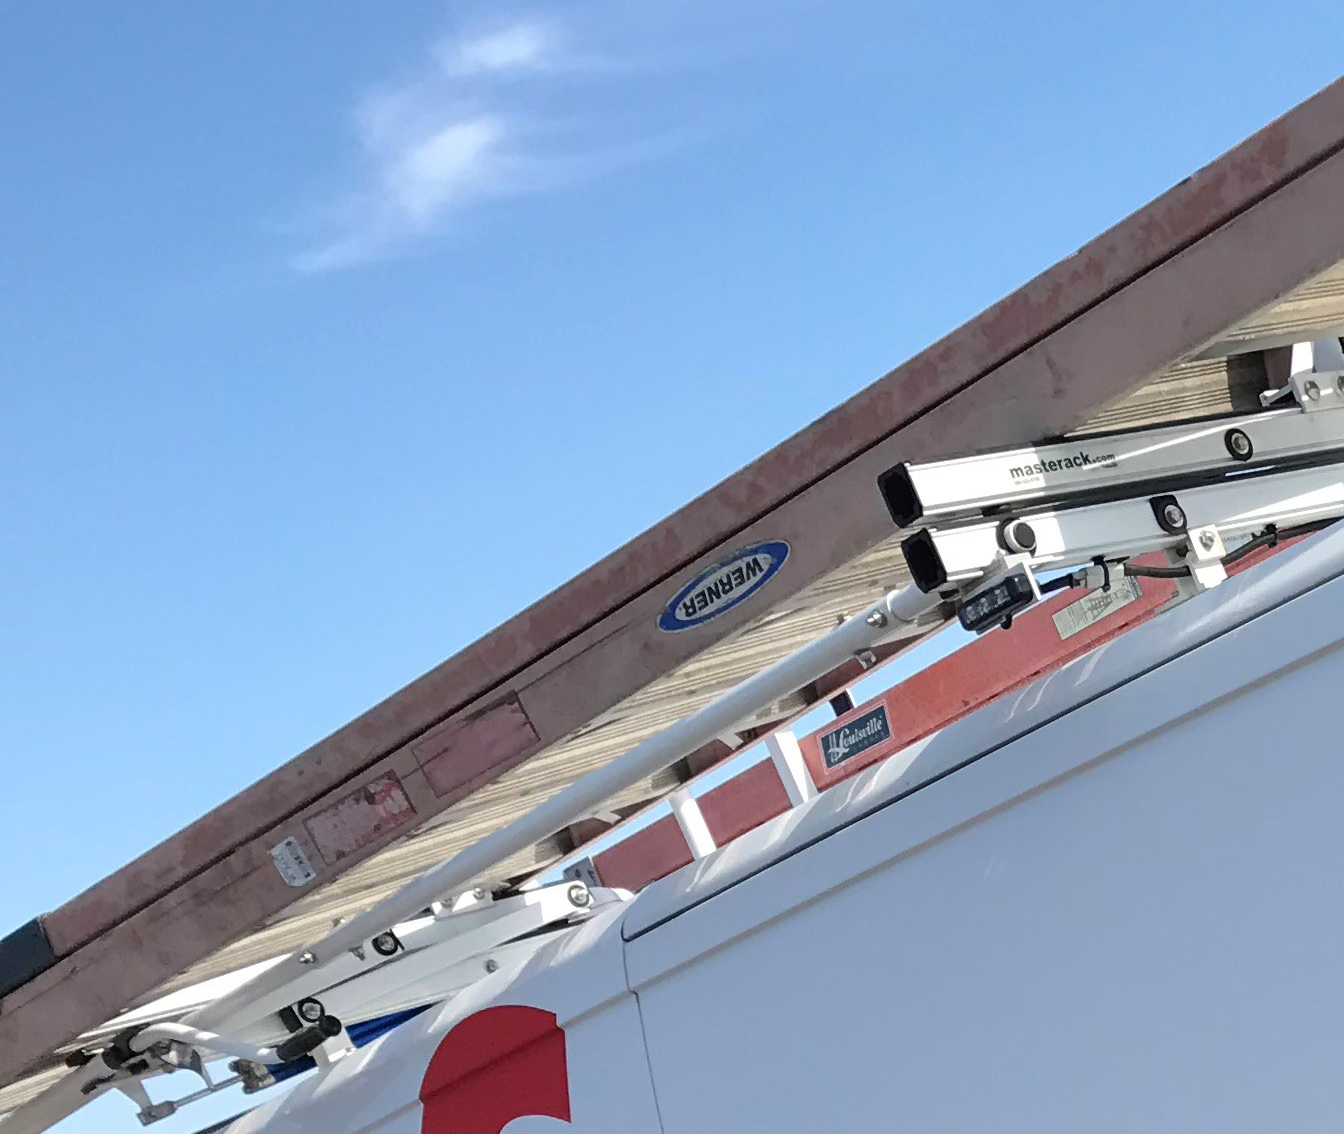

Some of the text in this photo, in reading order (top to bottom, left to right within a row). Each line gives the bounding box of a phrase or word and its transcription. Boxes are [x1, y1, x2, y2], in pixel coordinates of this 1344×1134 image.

[1009, 451, 1116, 479] masterack.com
[682, 557, 765, 618] WERNER
[827, 717, 883, 763] Louisville
